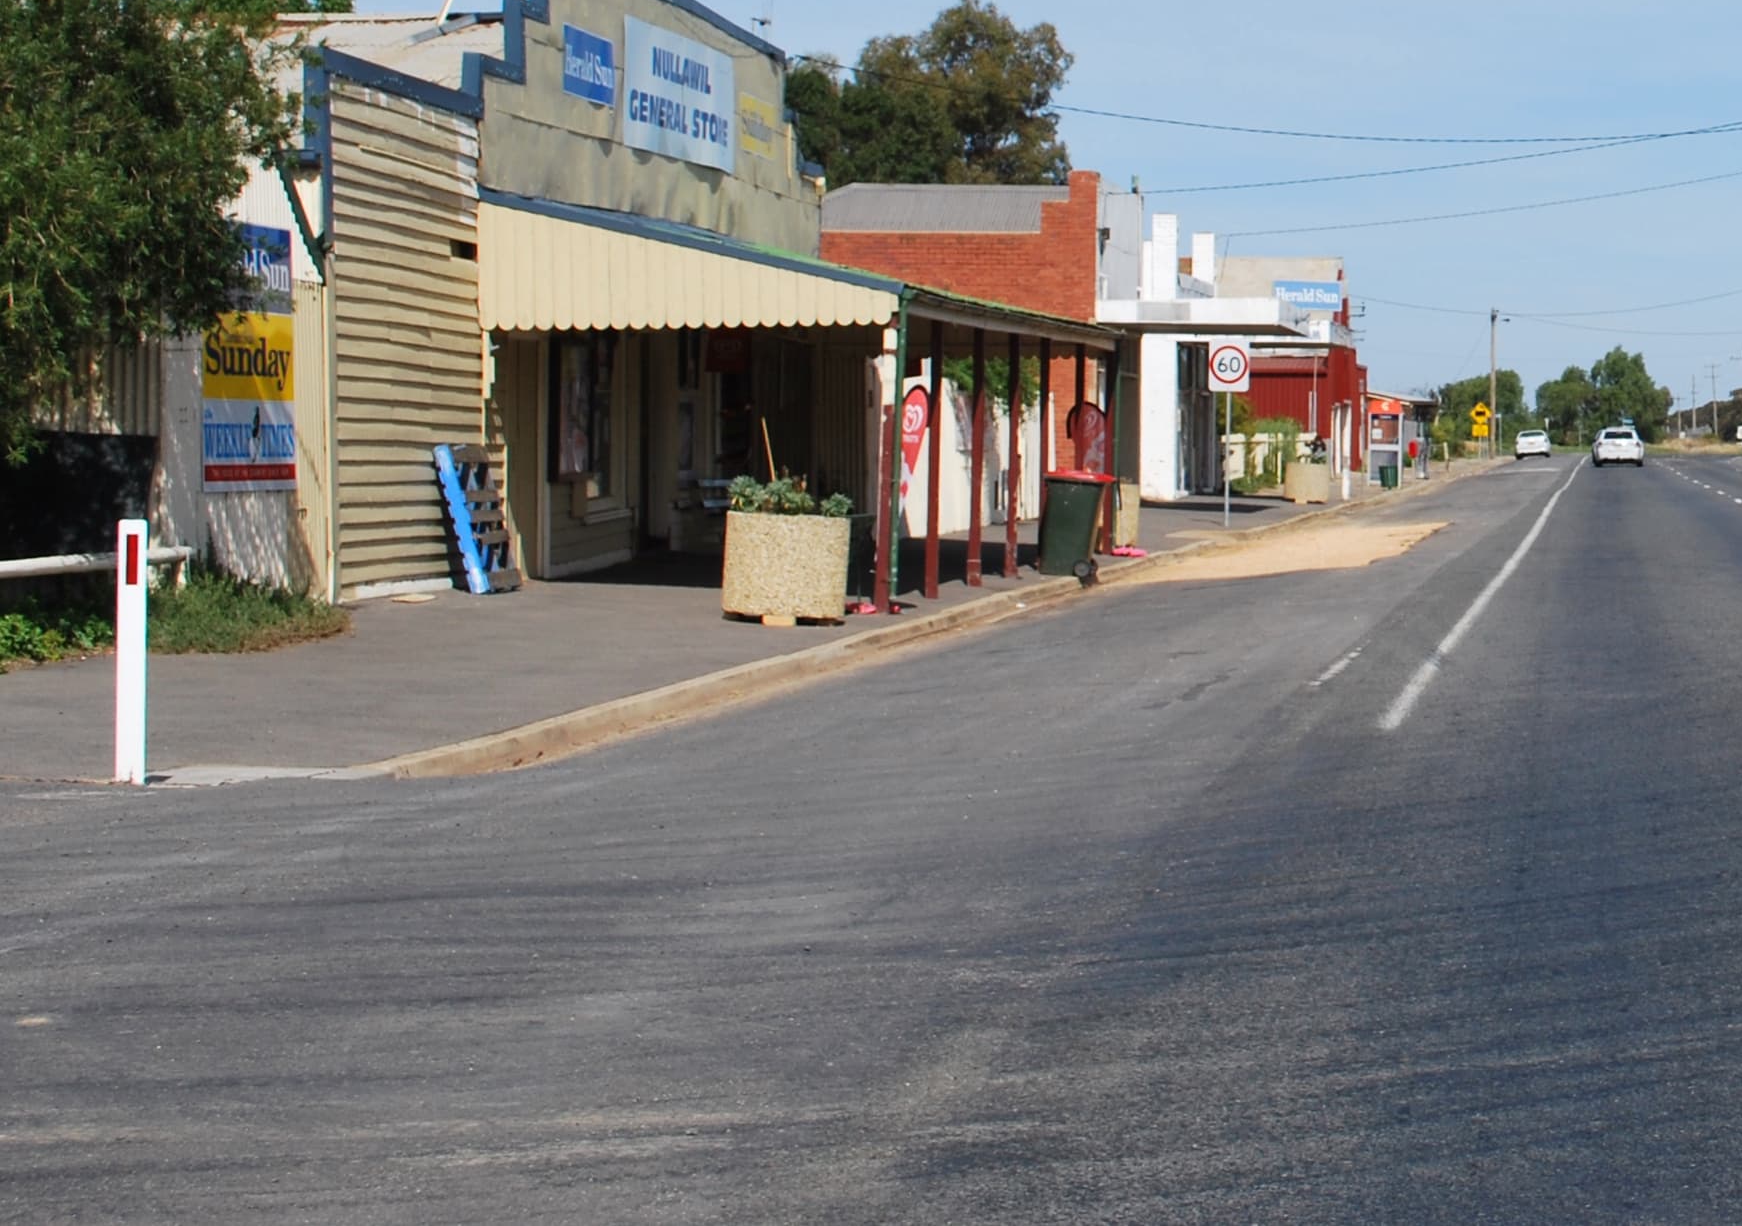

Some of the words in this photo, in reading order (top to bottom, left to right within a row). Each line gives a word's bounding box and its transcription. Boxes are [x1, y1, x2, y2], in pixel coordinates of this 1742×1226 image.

[565, 44, 594, 83] Herald
[594, 55, 614, 89] Sun
[652, 47, 711, 94] NULLAWIL
[629, 89, 687, 134] GENERAL
[692, 108, 728, 147] STORE
[1275, 286, 1314, 303] Herald
[1315, 288, 1338, 304] Sun
[205, 332, 291, 391] Sunday
[1217, 357, 1241, 374] 60
[260, 423, 295, 458] TIMES
